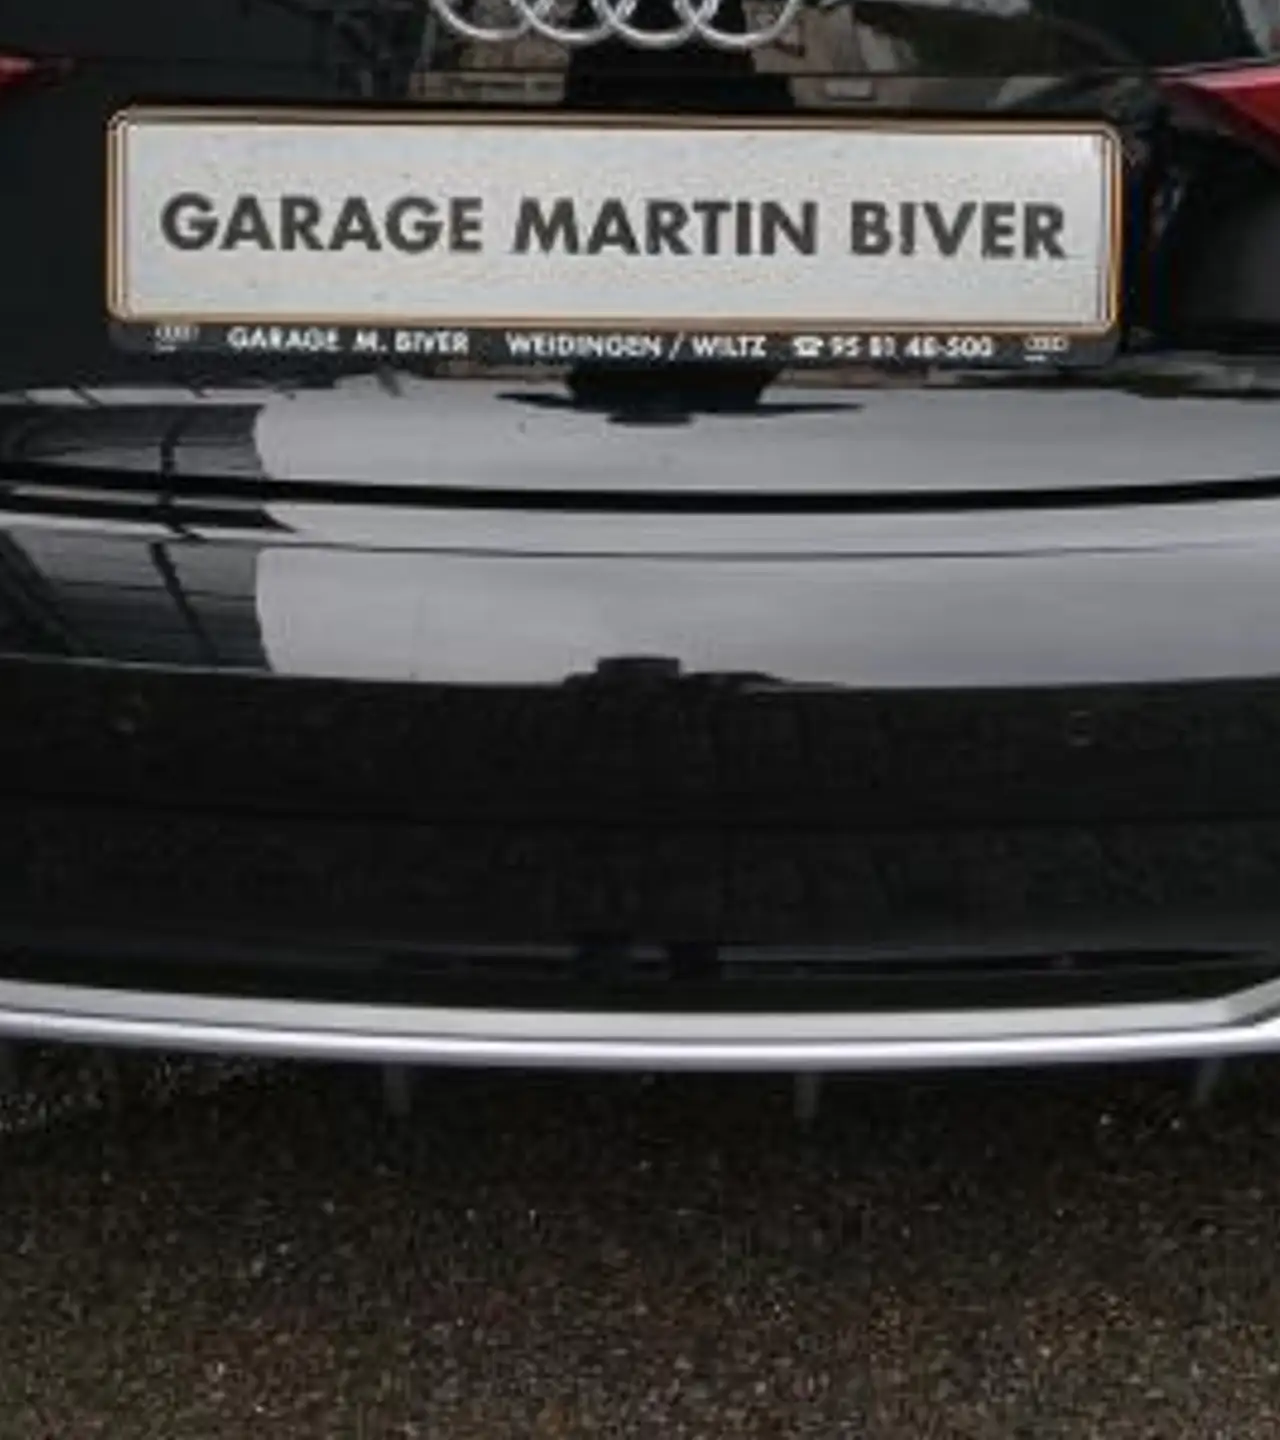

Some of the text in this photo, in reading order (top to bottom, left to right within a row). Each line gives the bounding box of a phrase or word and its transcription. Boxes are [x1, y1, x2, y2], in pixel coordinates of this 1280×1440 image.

[160, 192, 1066, 259] GARAGE MARTIN BIVER
[227, 326, 342, 352] GARAGE
[353, 330, 387, 353] M.
[394, 330, 469, 354] BIVER
[505, 331, 661, 357] WEIDINGEN
[692, 334, 767, 358] WILTZ
